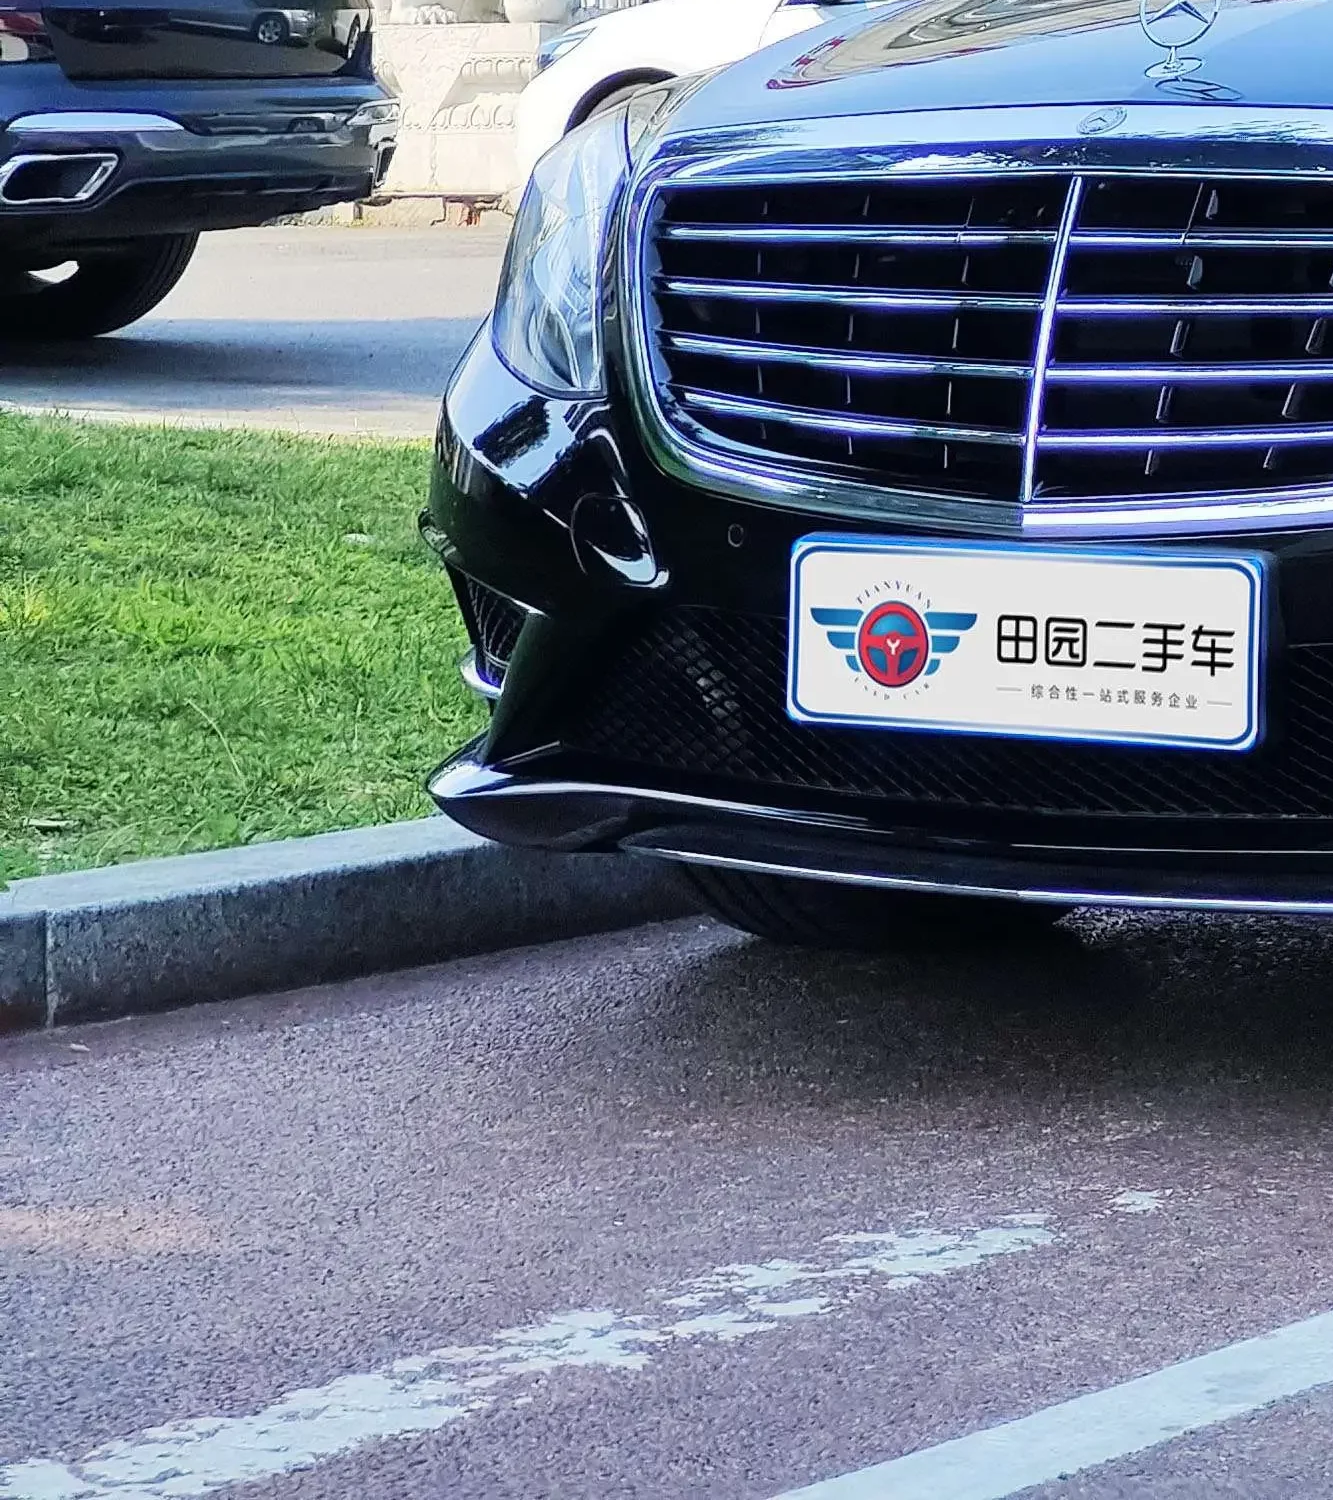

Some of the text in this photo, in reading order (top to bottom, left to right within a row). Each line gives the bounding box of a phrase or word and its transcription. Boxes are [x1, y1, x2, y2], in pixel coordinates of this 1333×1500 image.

[997, 614, 1236, 677] 田园二手车
[1030, 684, 1198, 710] 综合性一站式服务企业
